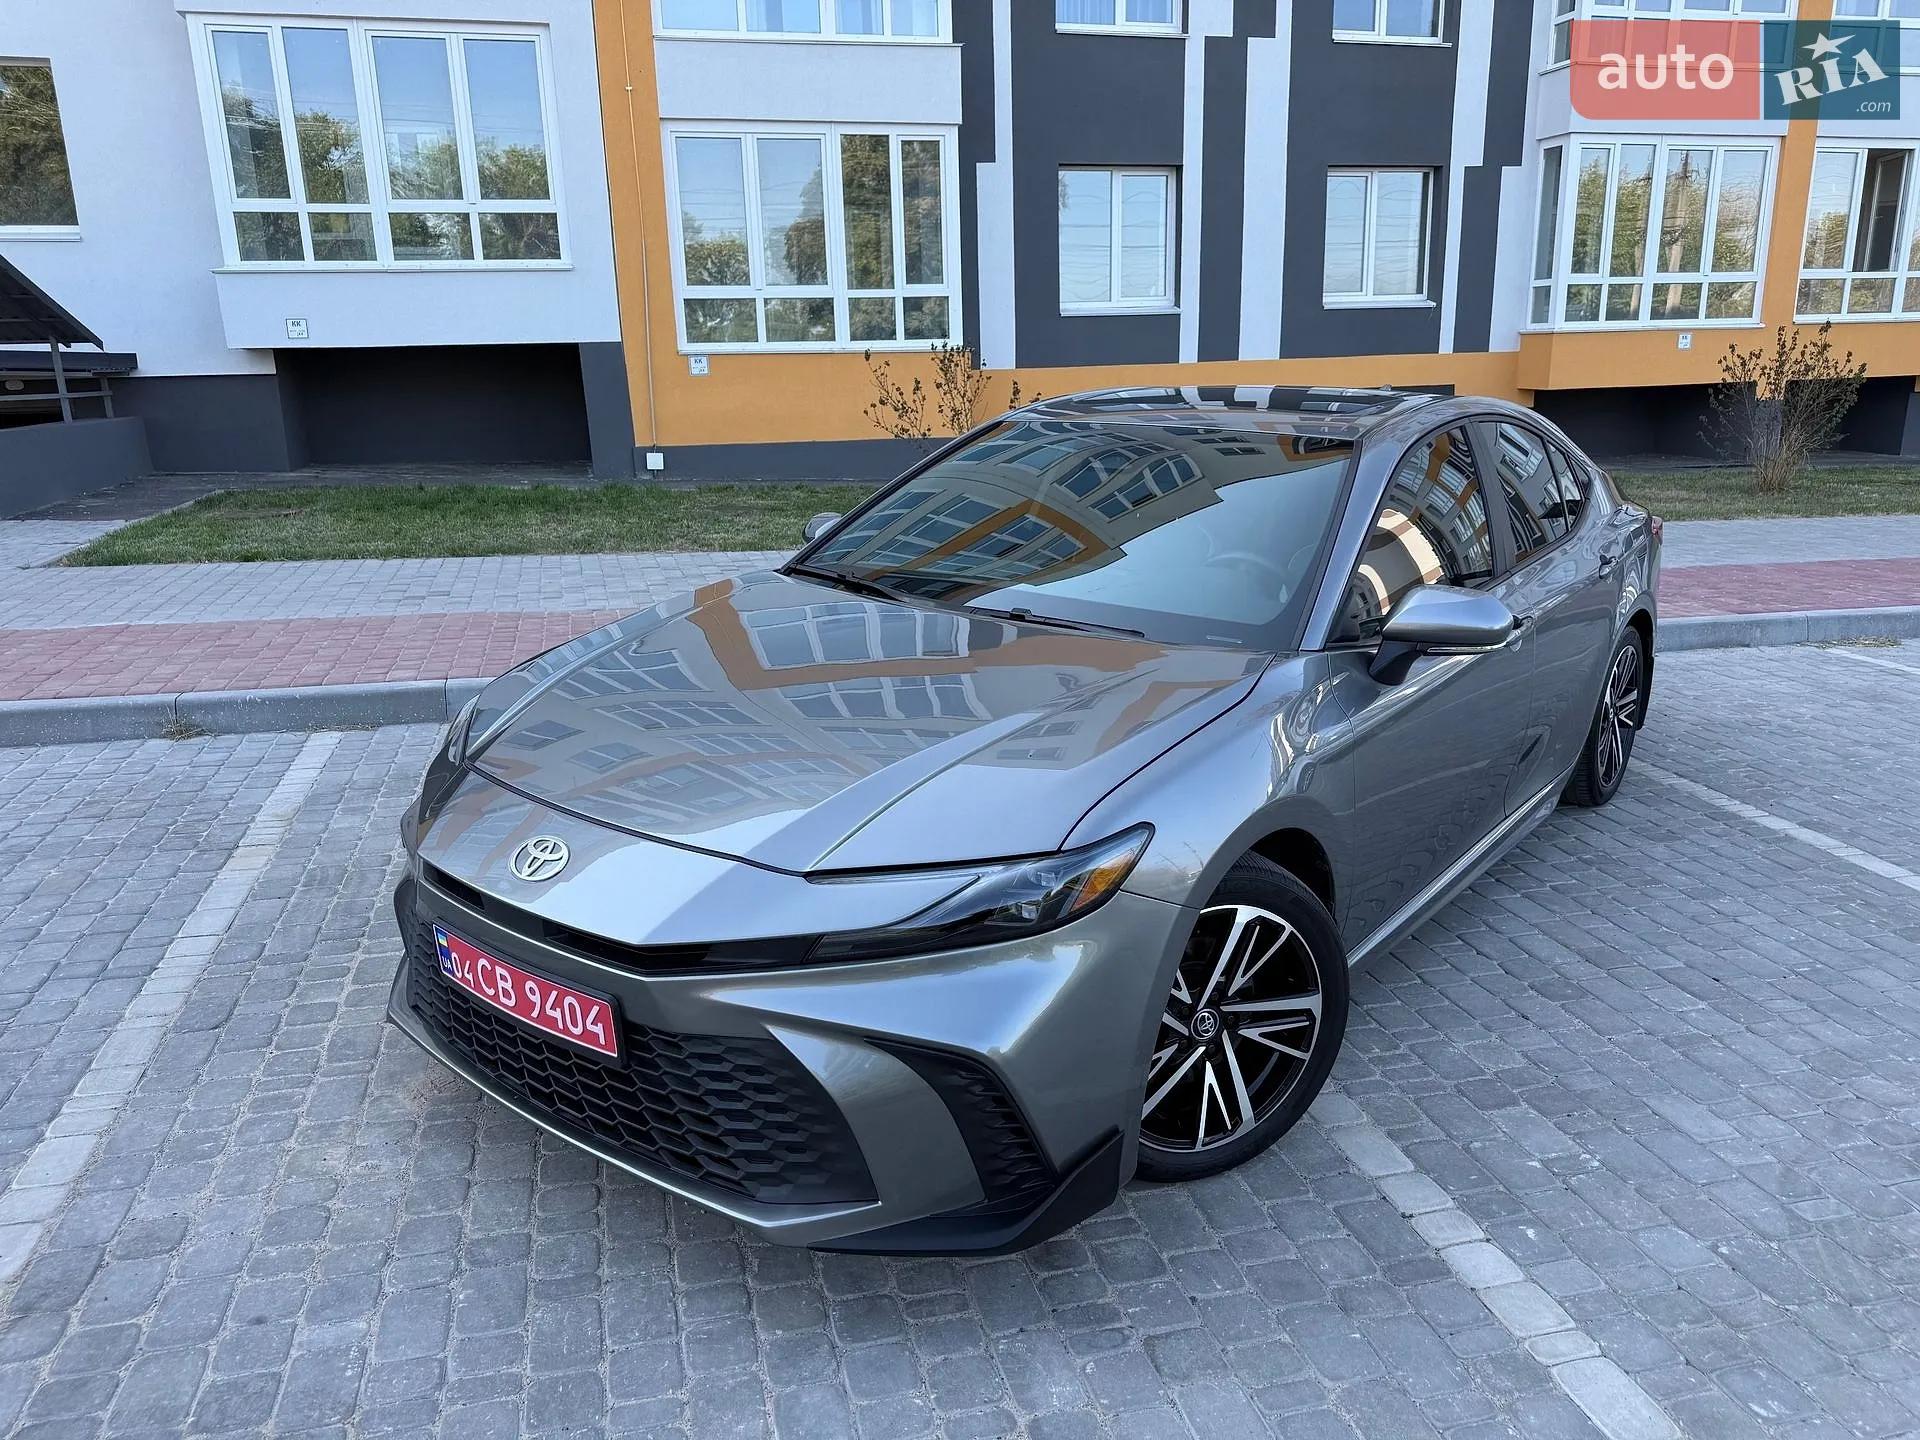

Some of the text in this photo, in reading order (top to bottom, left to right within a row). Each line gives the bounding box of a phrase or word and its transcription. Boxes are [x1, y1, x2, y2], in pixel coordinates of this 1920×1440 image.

[442, 955, 452, 971] UA
[451, 952, 606, 1046] 04 CB 9404
